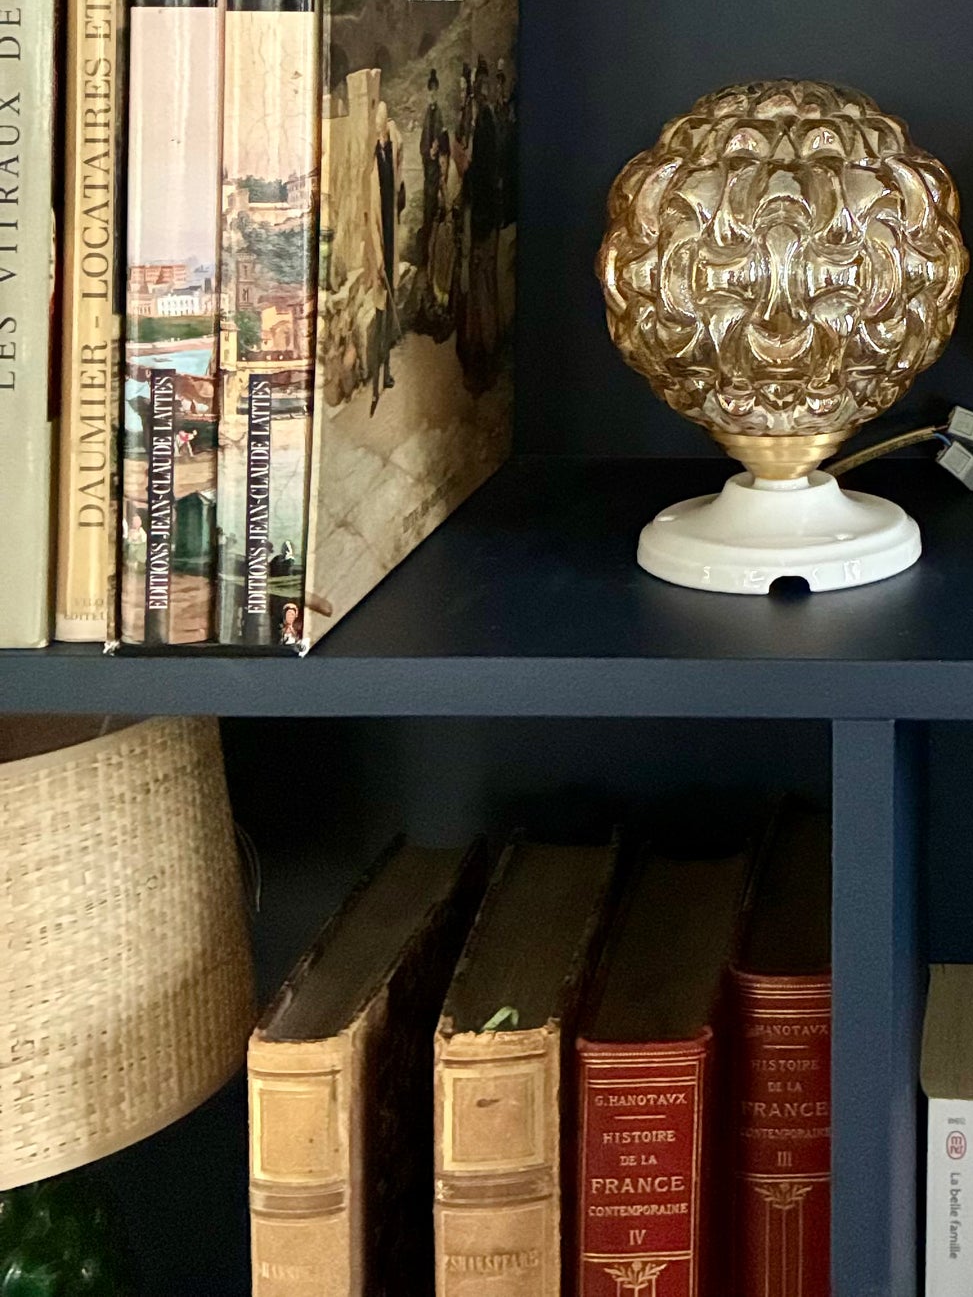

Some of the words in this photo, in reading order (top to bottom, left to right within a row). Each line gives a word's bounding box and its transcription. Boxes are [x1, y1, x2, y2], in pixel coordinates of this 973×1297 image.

[0, 7, 22, 61] DE
[0, 92, 20, 282] VITRAUX
[81, 57, 112, 302] LOCATAIRES
[0, 316, 17, 390] LES
[78, 341, 108, 530] DAUMIER
[150, 435, 173, 539] JEAN-CLAUDE
[249, 439, 271, 543] JEAN-CLAUDE
[751, 1059, 820, 1072] HISTOIRE
[768, 1081, 782, 1092] DE
[787, 1081, 803, 1092] LA
[742, 1102, 829, 1118] FRANCE
[603, 1130, 676, 1144] HISTOIRE
[620, 1155, 637, 1166] DE
[641, 1154, 658, 1165] LA
[777, 1151, 793, 1167] III
[590, 1176, 686, 1195] FRANCE
[950, 1172, 961, 1185] La
[588, 1203, 689, 1218] CONTEMPORAINE
[950, 1188, 962, 1217] belle
[629, 1230, 647, 1246] IV
[949, 1220, 962, 1259] famille
